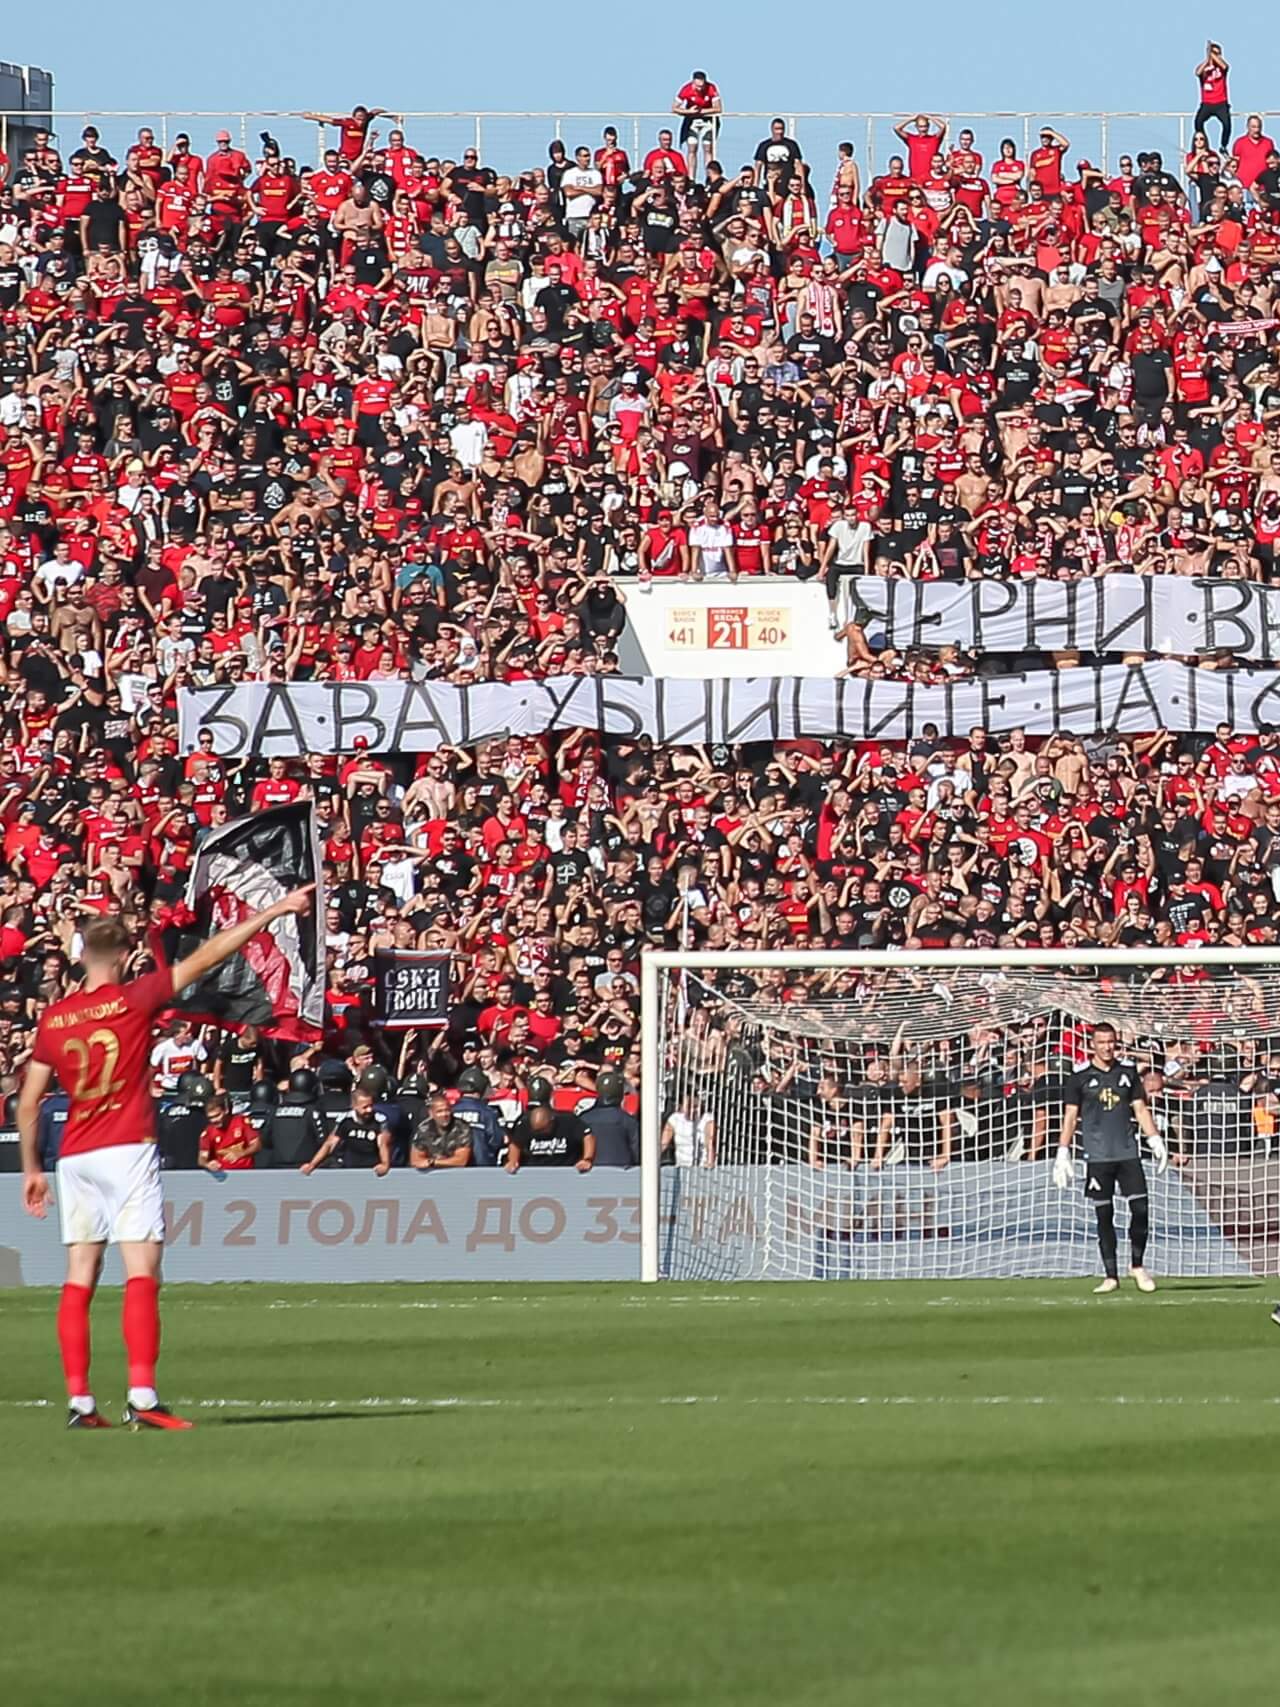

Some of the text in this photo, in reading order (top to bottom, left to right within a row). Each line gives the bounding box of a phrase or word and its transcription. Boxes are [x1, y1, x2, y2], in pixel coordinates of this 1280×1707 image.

[676, 628, 695, 645] 41
[713, 621, 743, 648] 21
[757, 627, 778, 645] 40
[188, 682, 304, 756] ЗА
[1052, 663, 1168, 735] НА
[63, 1028, 127, 1100] 22
[223, 1199, 257, 1246] 2
[277, 1197, 450, 1246] ГОЛА
[466, 1196, 568, 1252] ДО
